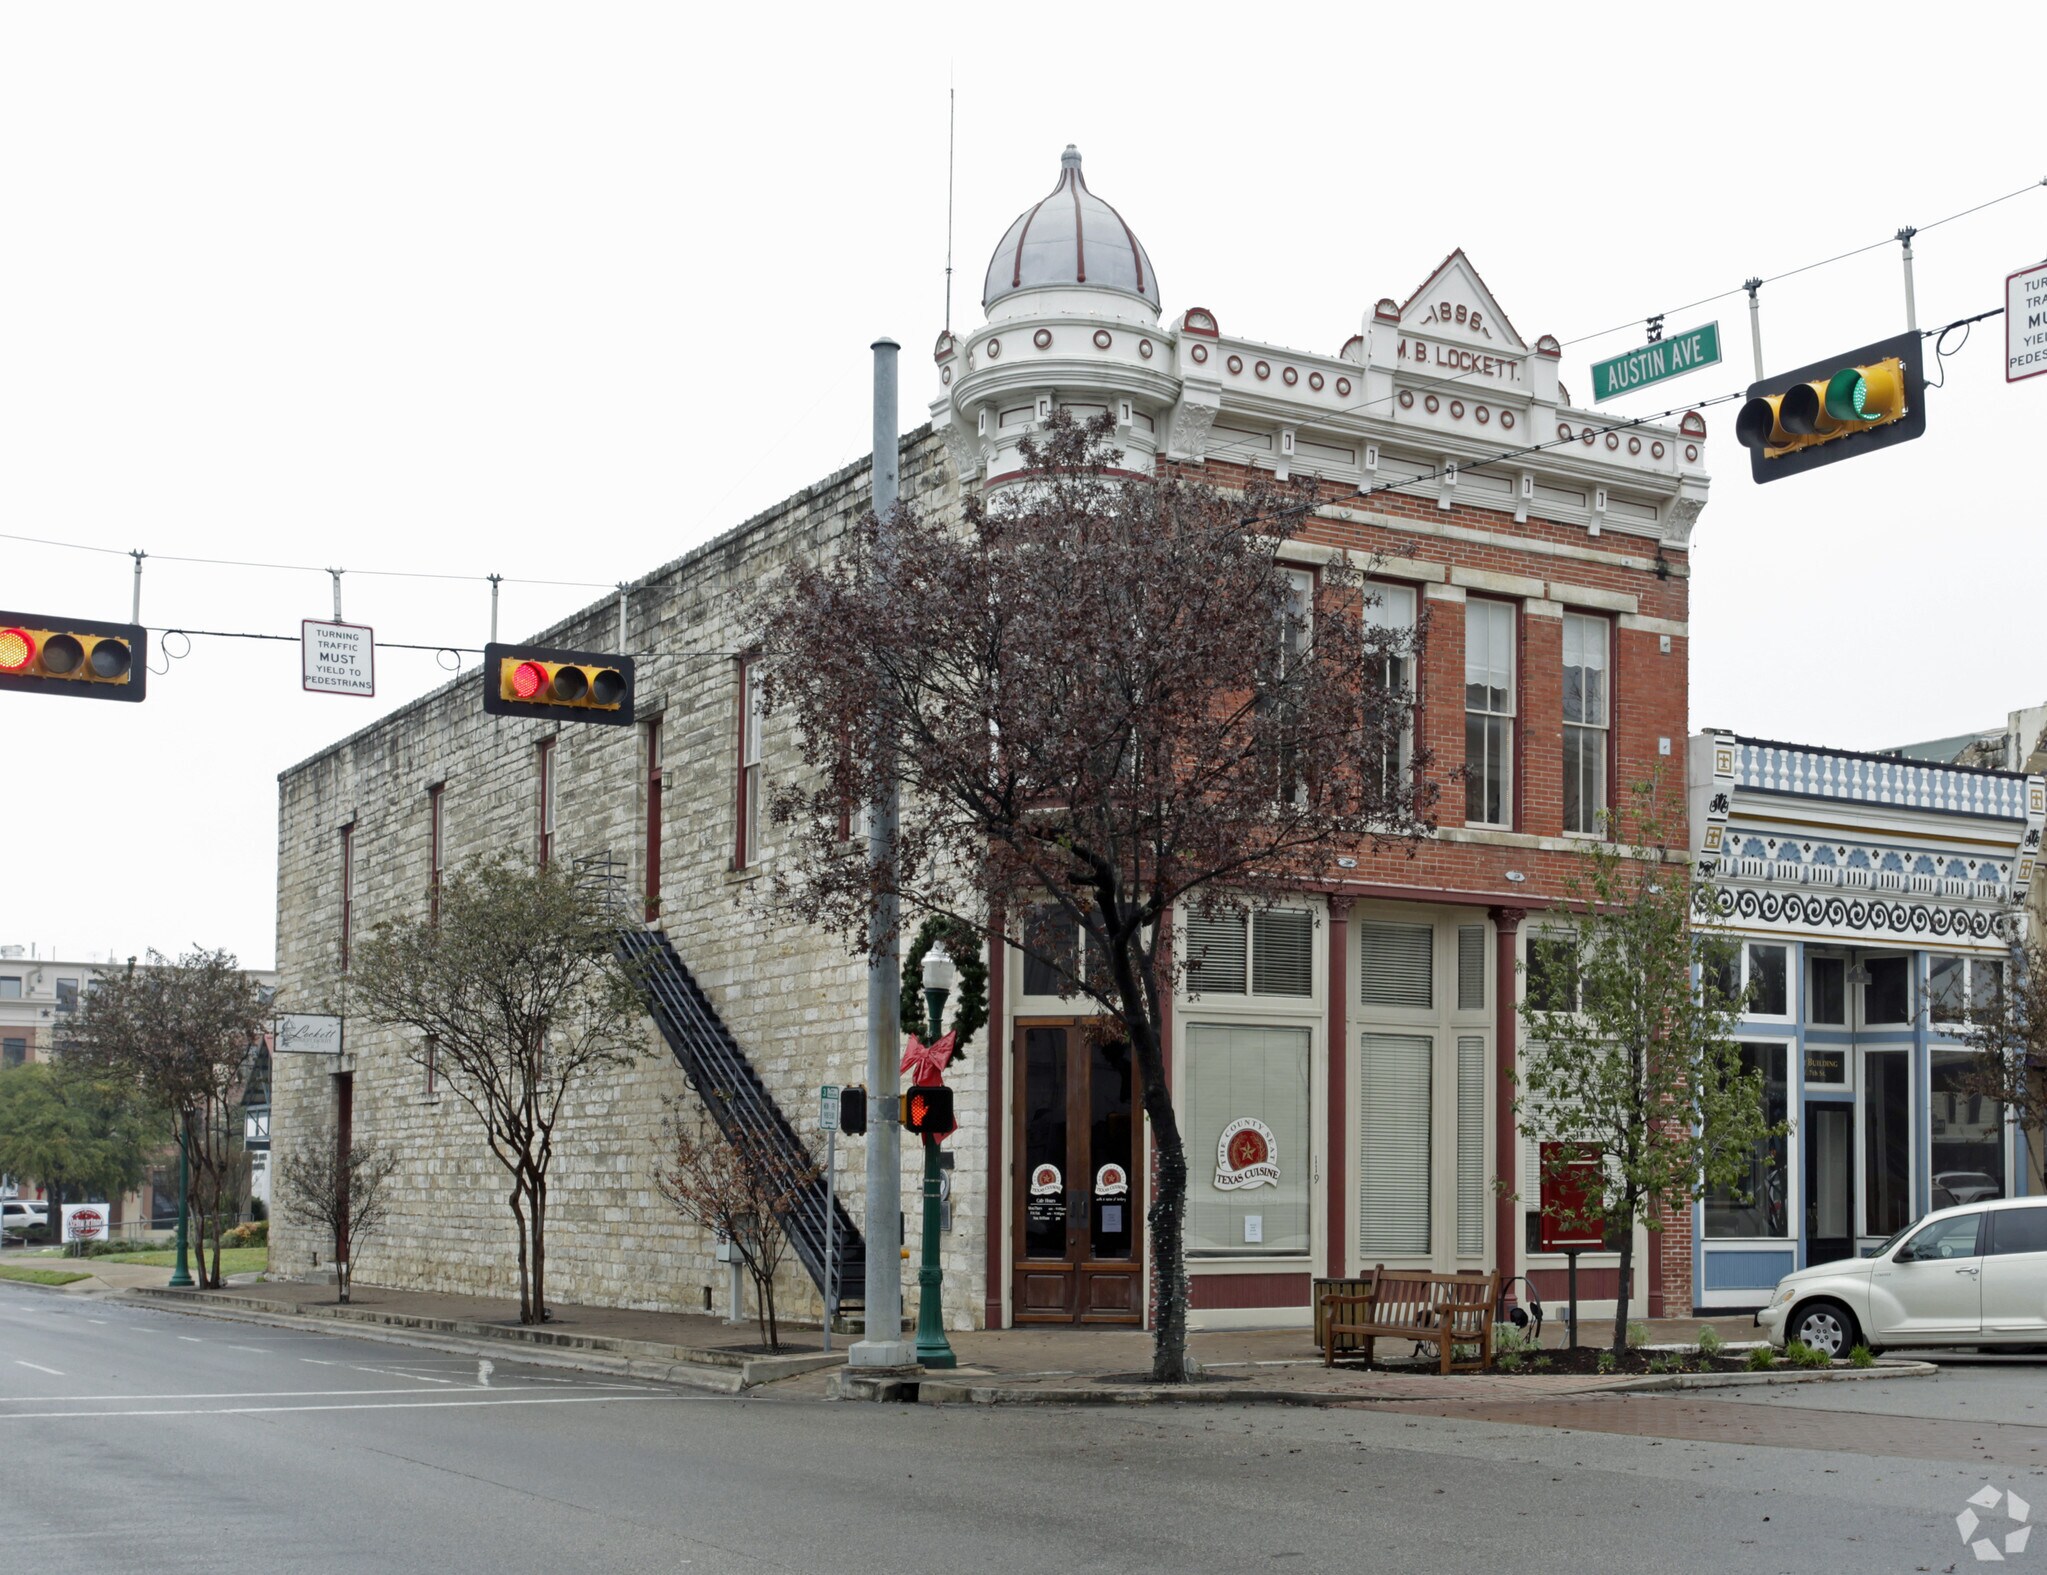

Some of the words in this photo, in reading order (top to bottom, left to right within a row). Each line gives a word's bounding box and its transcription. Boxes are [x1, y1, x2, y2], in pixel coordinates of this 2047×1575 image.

[1430, 301, 1483, 331] 1896
[1608, 347, 1665, 392] AUSTIN
[1672, 334, 1704, 371] AVE
[316, 629, 359, 641] TURNING
[318, 640, 358, 652] TRAFFIC
[320, 652, 356, 665] MUST
[316, 665, 345, 675] YIELD
[349, 668, 361, 677] TO
[305, 675, 372, 689] PEDESTRIANS
[1225, 1119, 1264, 1138] COUNTY
[1265, 1131, 1276, 1159] SEAT
[1217, 1173, 1244, 1185] TEXAS
[1244, 1167, 1279, 1180] CUISINE
